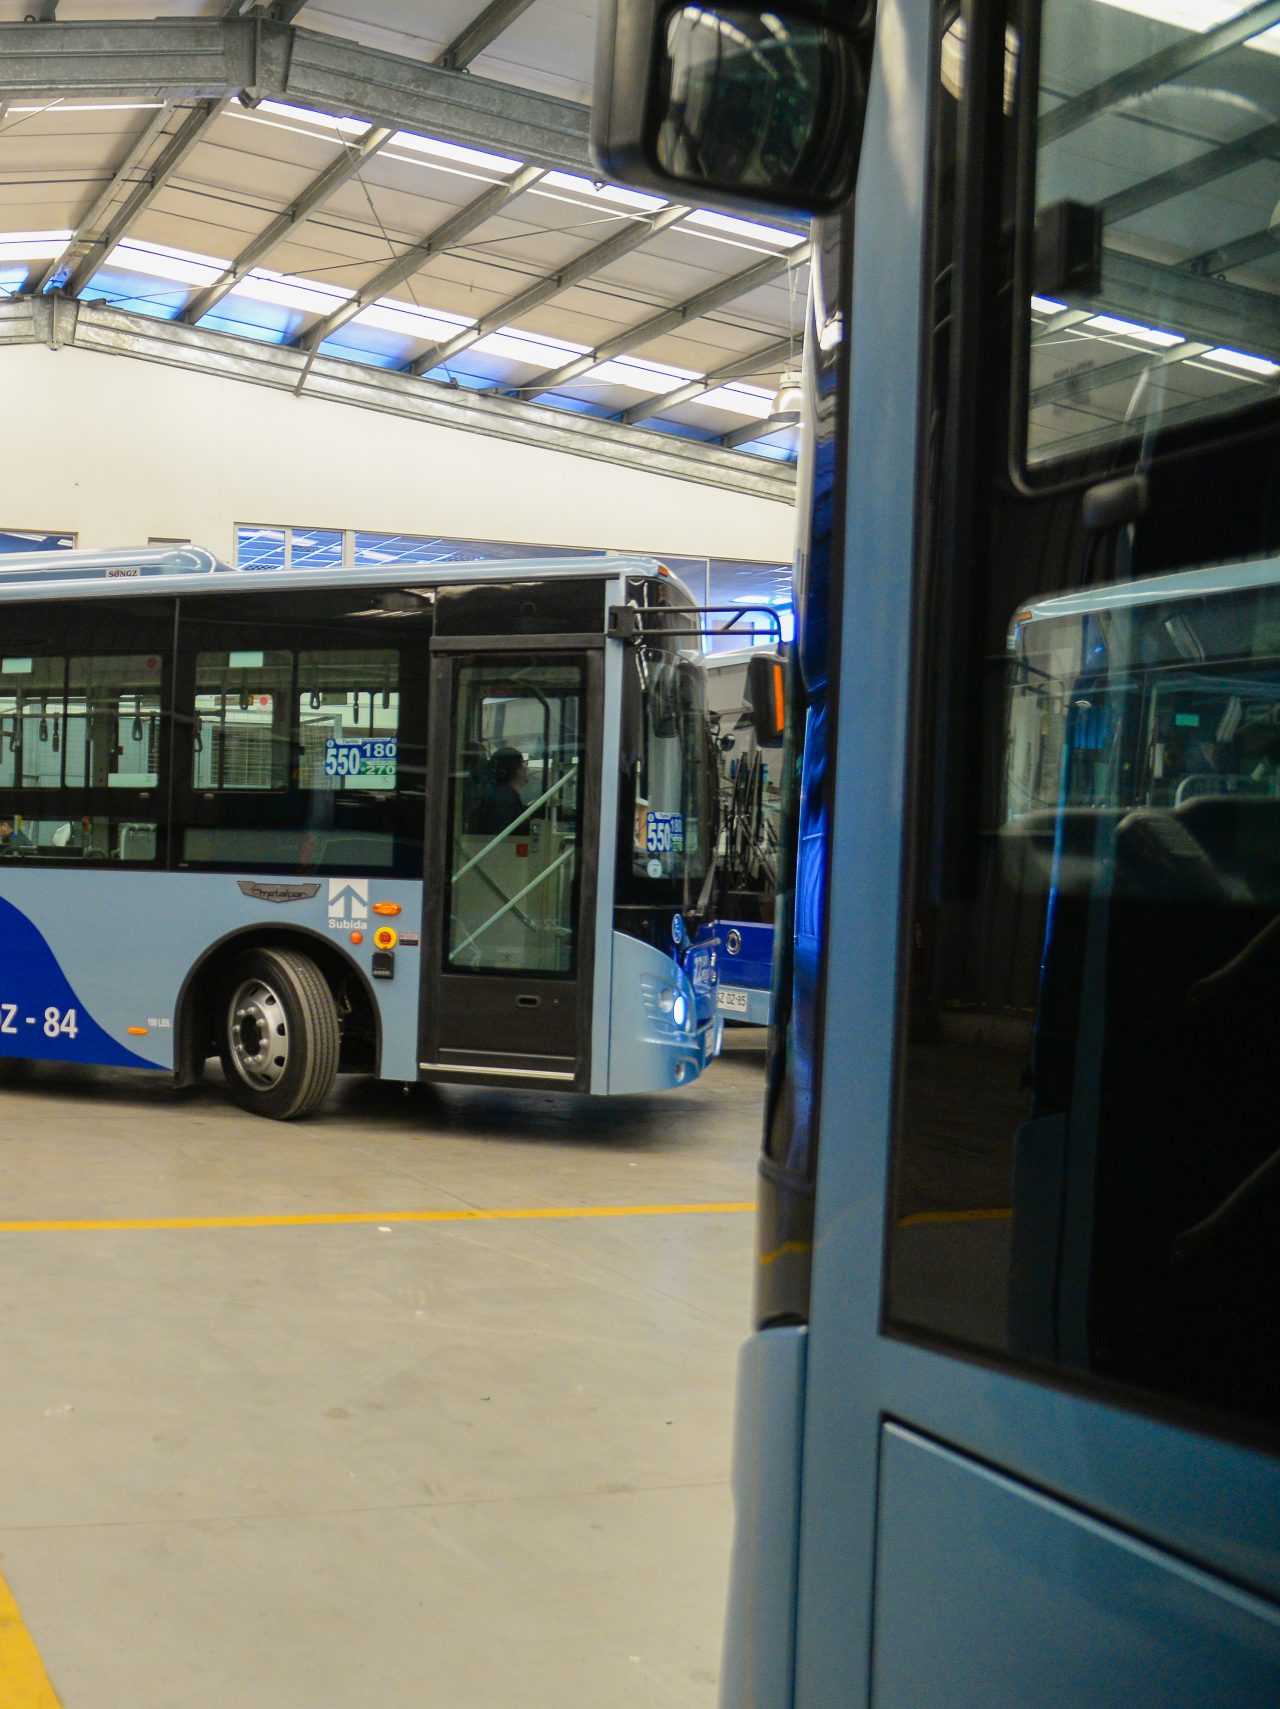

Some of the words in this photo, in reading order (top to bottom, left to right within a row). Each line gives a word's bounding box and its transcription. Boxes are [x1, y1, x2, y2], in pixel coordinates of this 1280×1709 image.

[108, 569, 138, 578] SONGZ
[362, 743, 396, 757] 180
[325, 747, 360, 775] 550
[366, 765, 396, 775] 270
[647, 822, 671, 851] 550
[328, 919, 368, 930] Subida
[43, 1006, 78, 1039] 84
